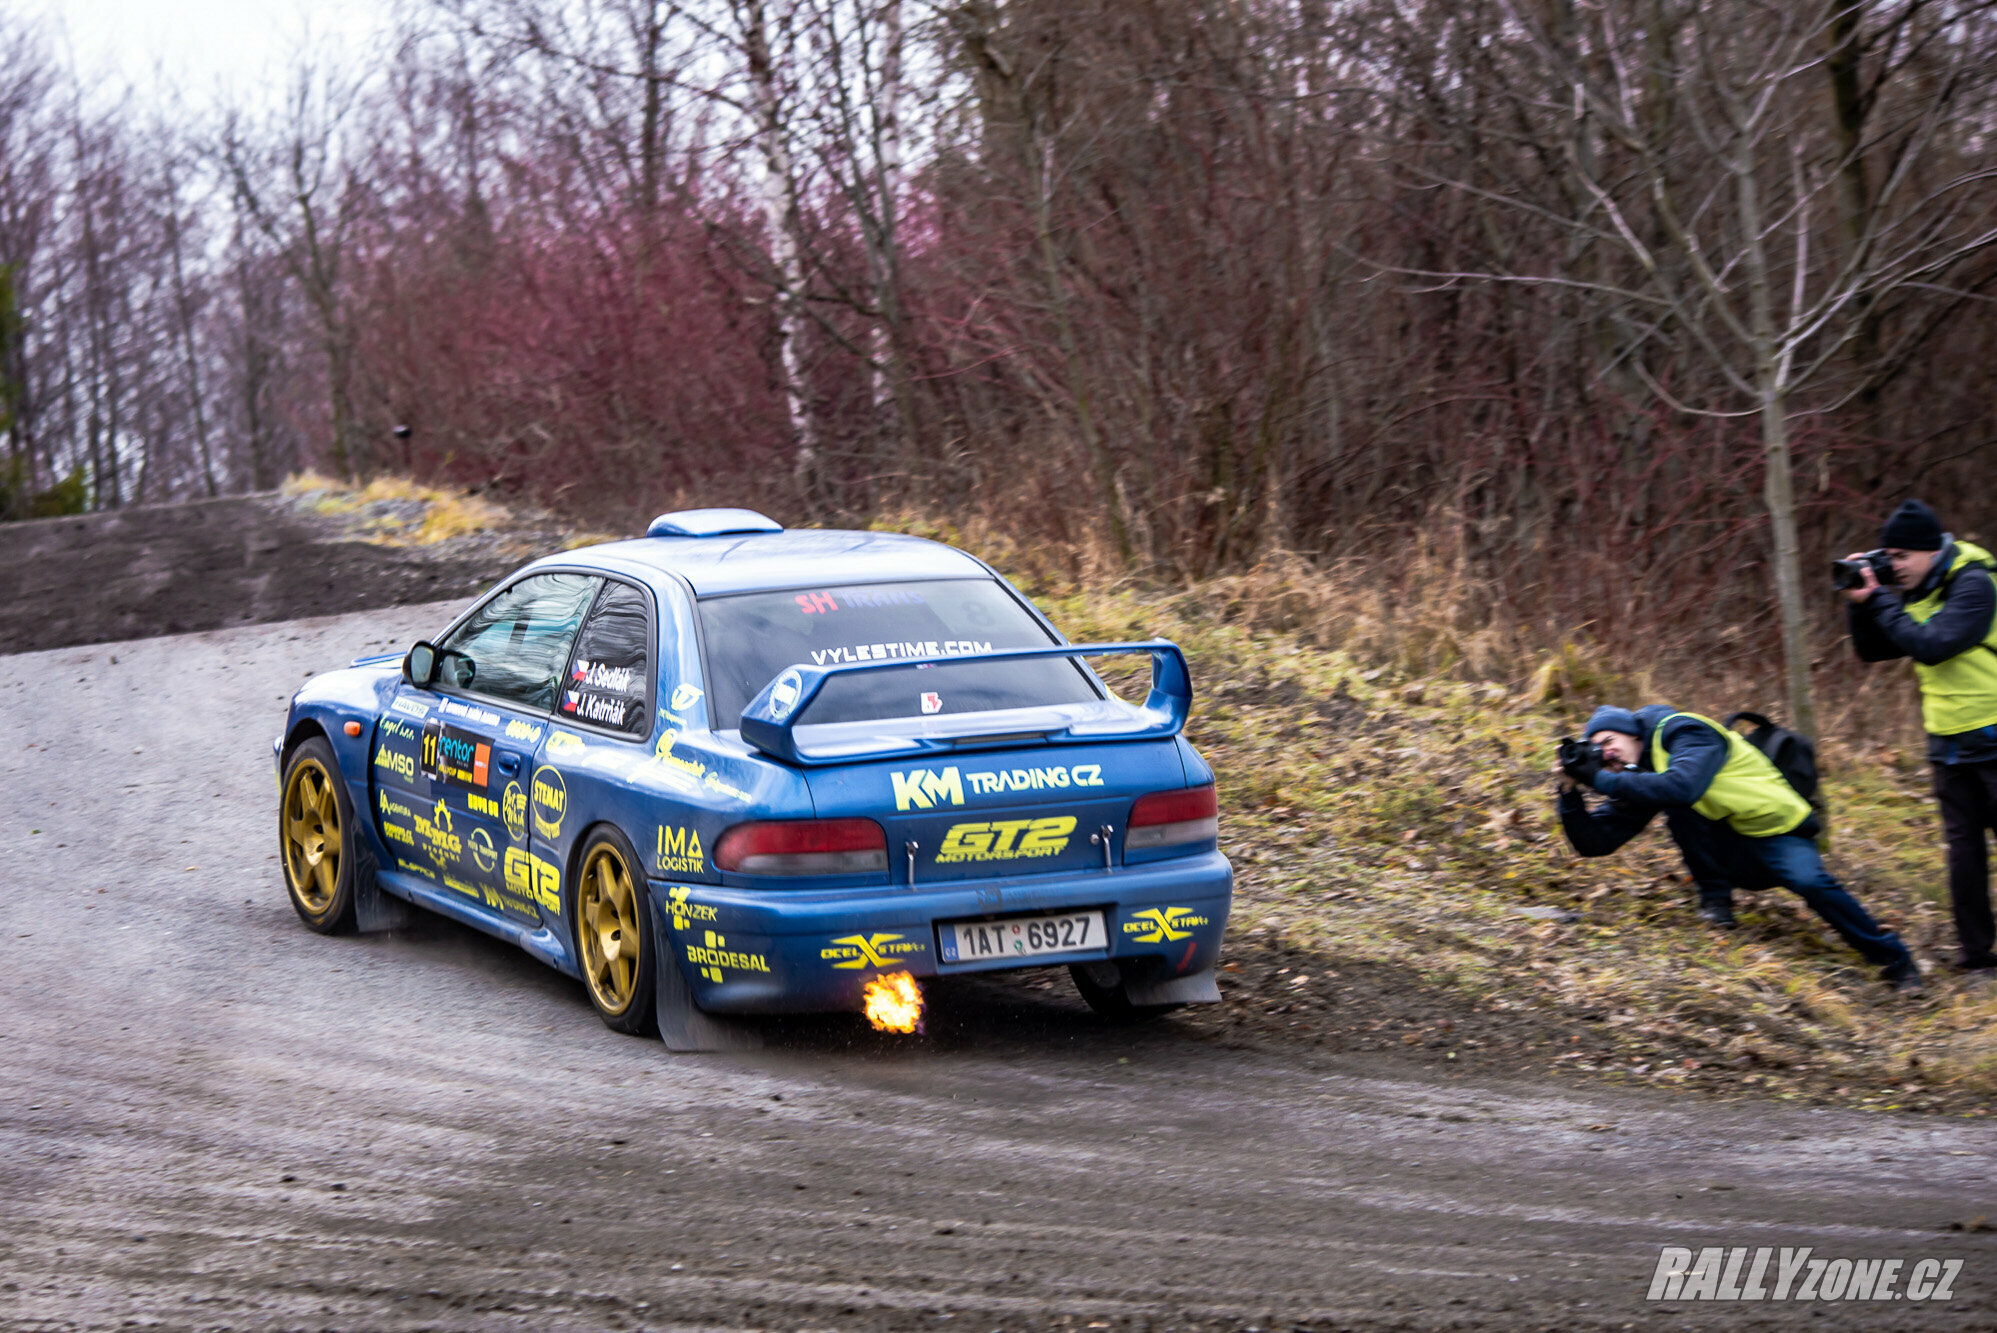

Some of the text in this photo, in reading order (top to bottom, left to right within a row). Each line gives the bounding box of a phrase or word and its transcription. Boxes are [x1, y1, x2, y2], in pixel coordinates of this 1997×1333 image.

[795, 591, 839, 614] SH
[811, 641, 993, 665] VYLESTIME.COM
[594, 663, 631, 693] Sedlák
[576, 692, 587, 716] J.
[424, 733, 437, 768] 11
[534, 779, 564, 813] STEMAT
[890, 764, 1105, 811] KM TRADING CZ
[657, 825, 704, 858] IMA
[941, 816, 1078, 855] GT2
[656, 855, 704, 873] LOGISTIK
[935, 845, 1065, 863] MOTORSPORT
[504, 846, 560, 901] GT2
[666, 900, 718, 922] HONZEK
[963, 924, 1006, 956] 1AT
[1028, 916, 1091, 949] 6927
[686, 945, 771, 972] BRODESAL
